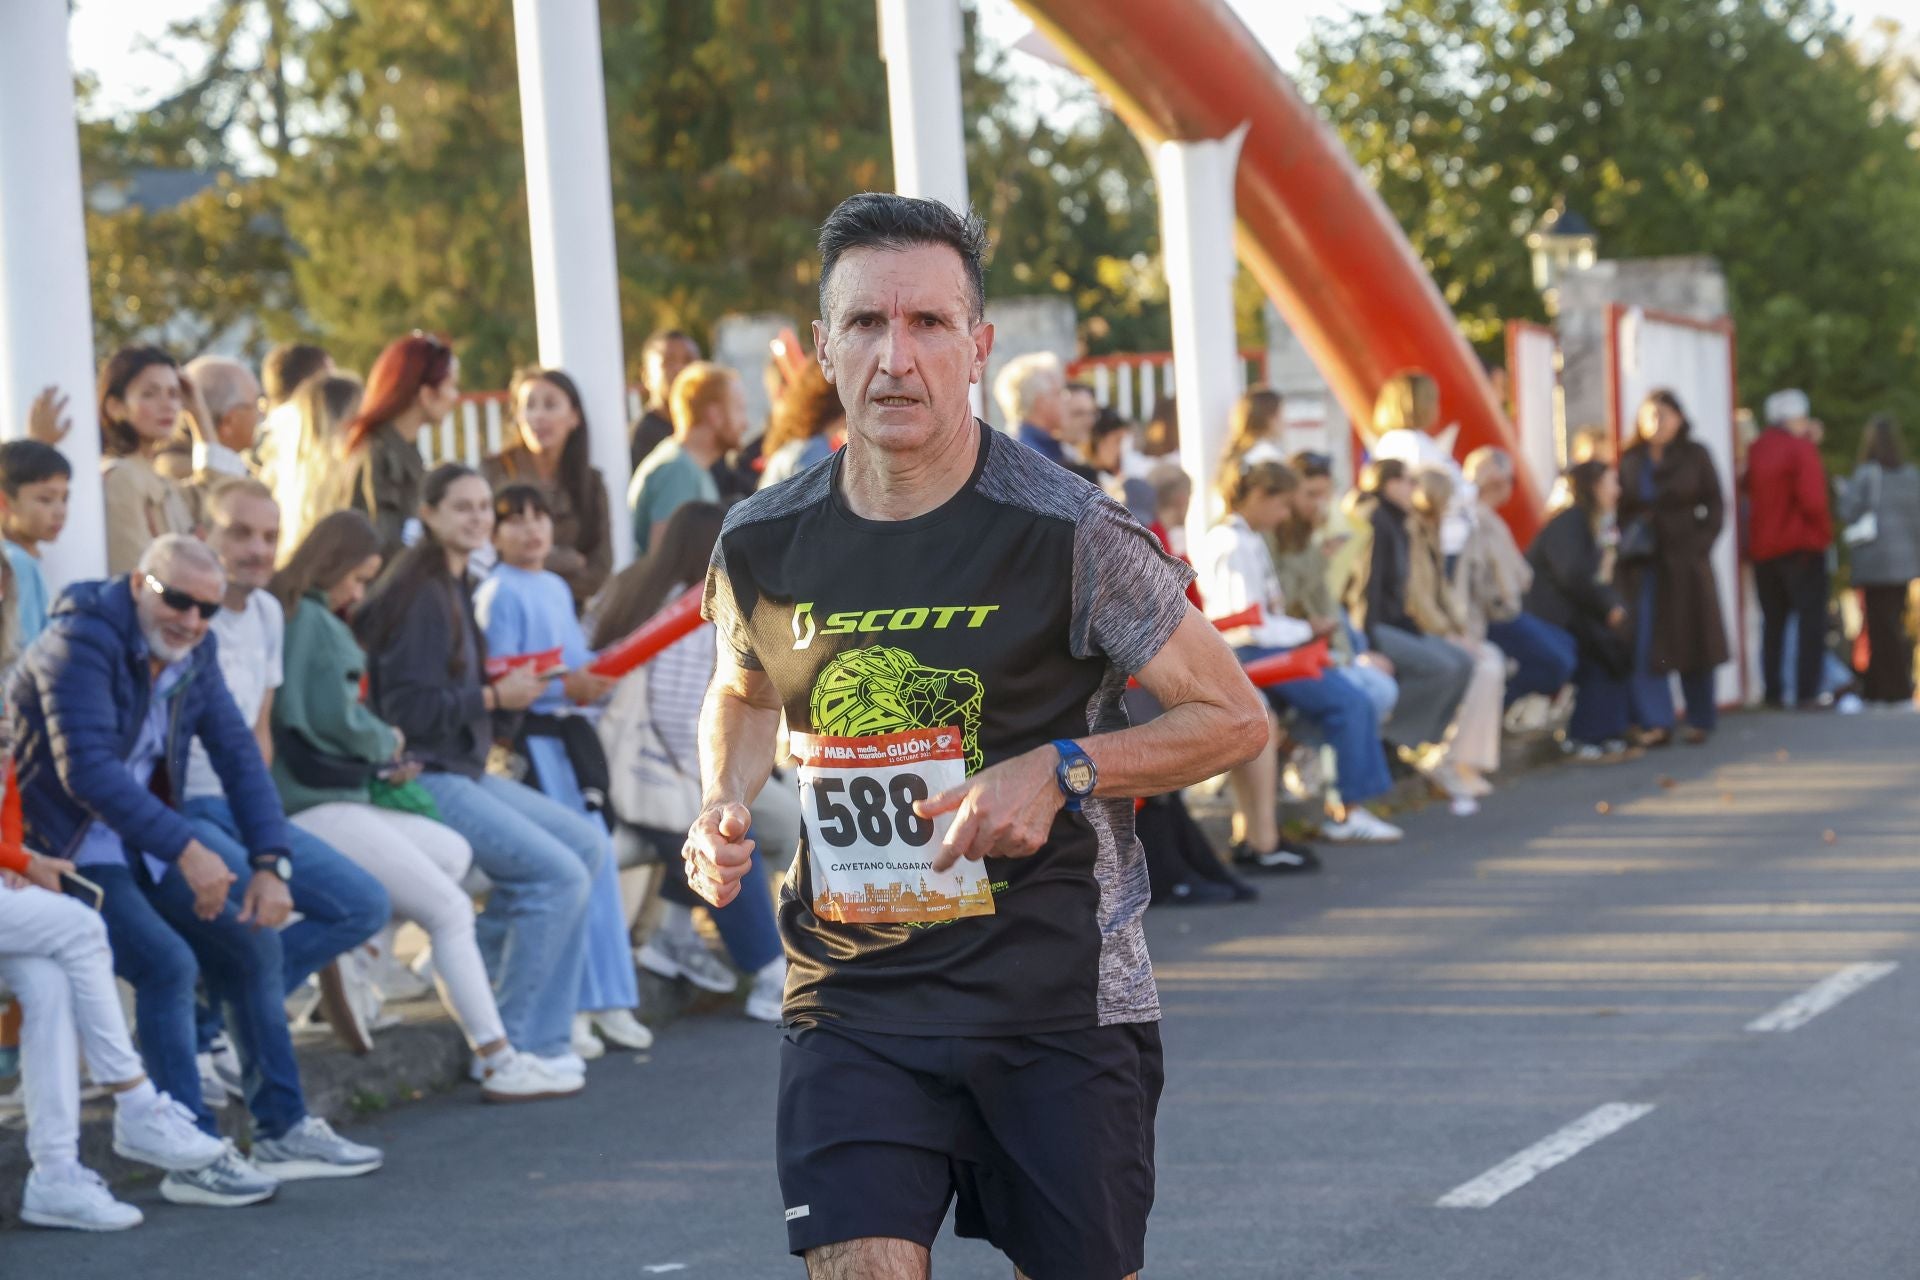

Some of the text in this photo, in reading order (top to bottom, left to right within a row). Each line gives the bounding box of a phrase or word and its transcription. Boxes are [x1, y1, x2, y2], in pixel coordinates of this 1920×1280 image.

[820, 605, 1000, 635] SCOTT
[824, 746, 856, 759] MBA
[857, 745, 878, 753] media
[858, 750, 887, 759] maratón
[887, 738, 931, 757] GIJÓN
[813, 773, 934, 847] 588
[831, 861, 933, 872] CAYETANO OLAGARAY
